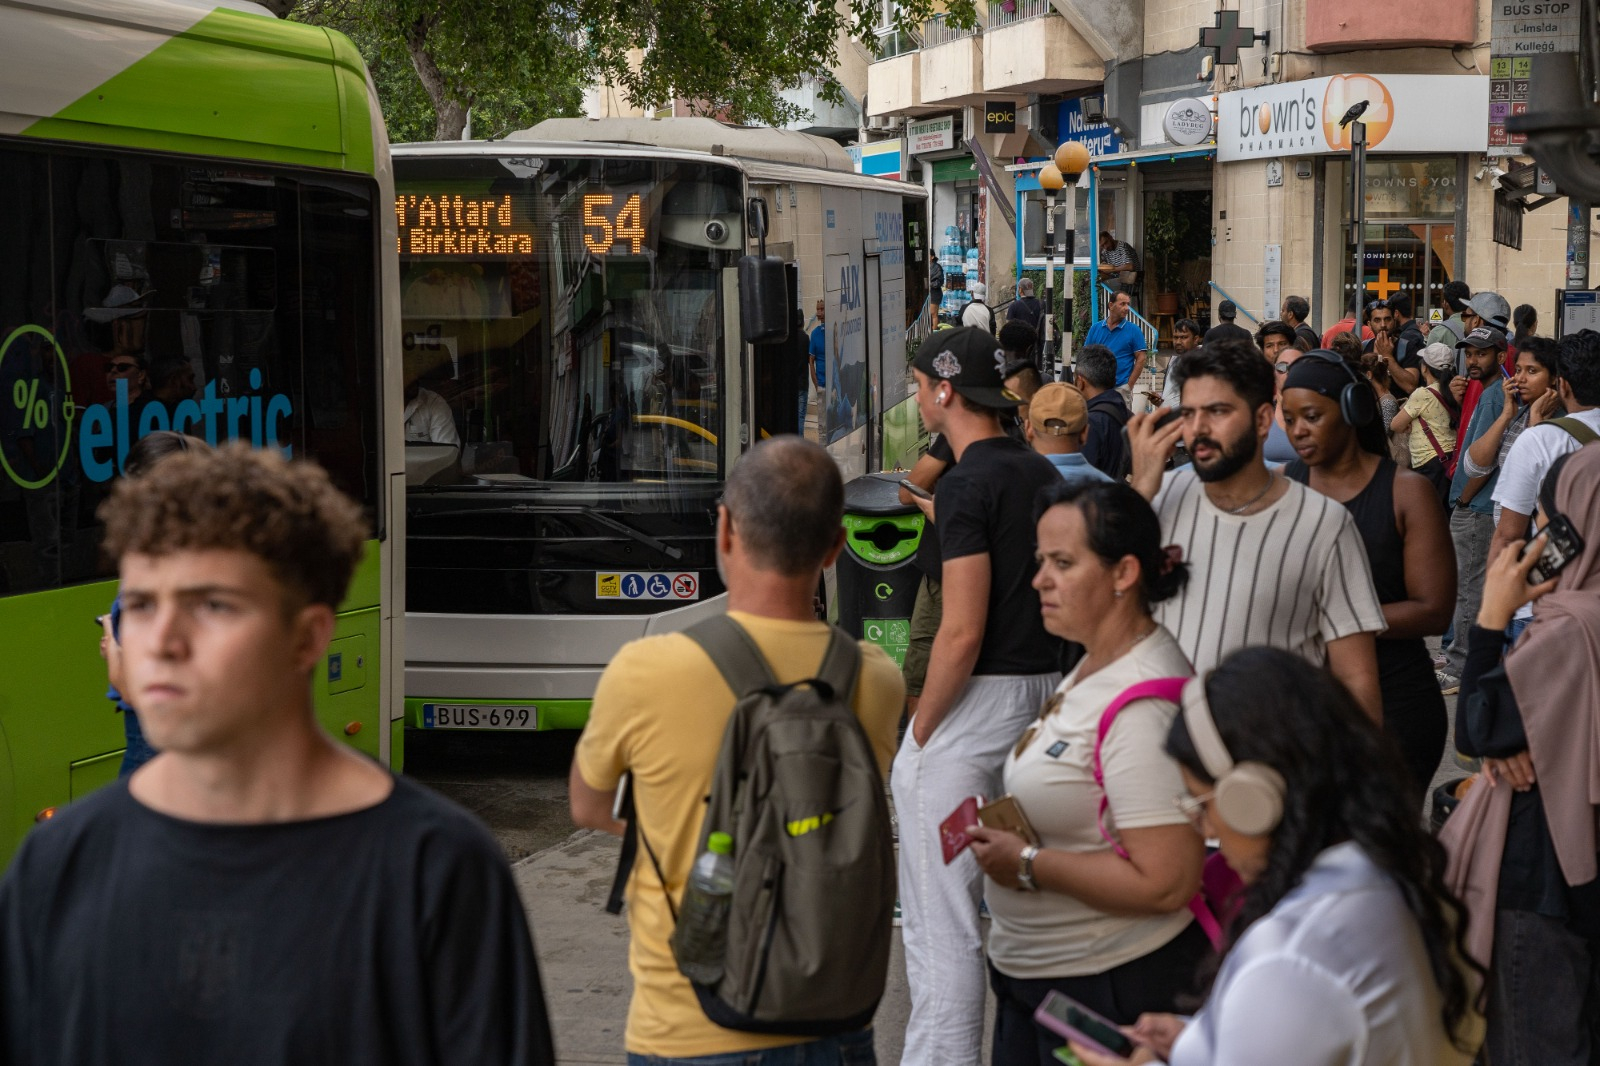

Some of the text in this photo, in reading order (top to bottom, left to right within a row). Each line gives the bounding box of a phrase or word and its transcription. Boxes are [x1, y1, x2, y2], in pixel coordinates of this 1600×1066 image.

[1503, 3, 1570, 16] BUS STOP
[987, 110, 1014, 124] epic
[1240, 87, 1316, 138] brown's
[1172, 121, 1204, 129] LADYBUG
[1069, 135, 1105, 156] tery
[1240, 135, 1316, 153] PHARMACY
[1364, 178, 1417, 187] ROWNS
[584, 194, 645, 255] 54
[410, 228, 532, 253] Birkirkara
[438, 707, 480, 726] BUS
[489, 708, 530, 726] 699
